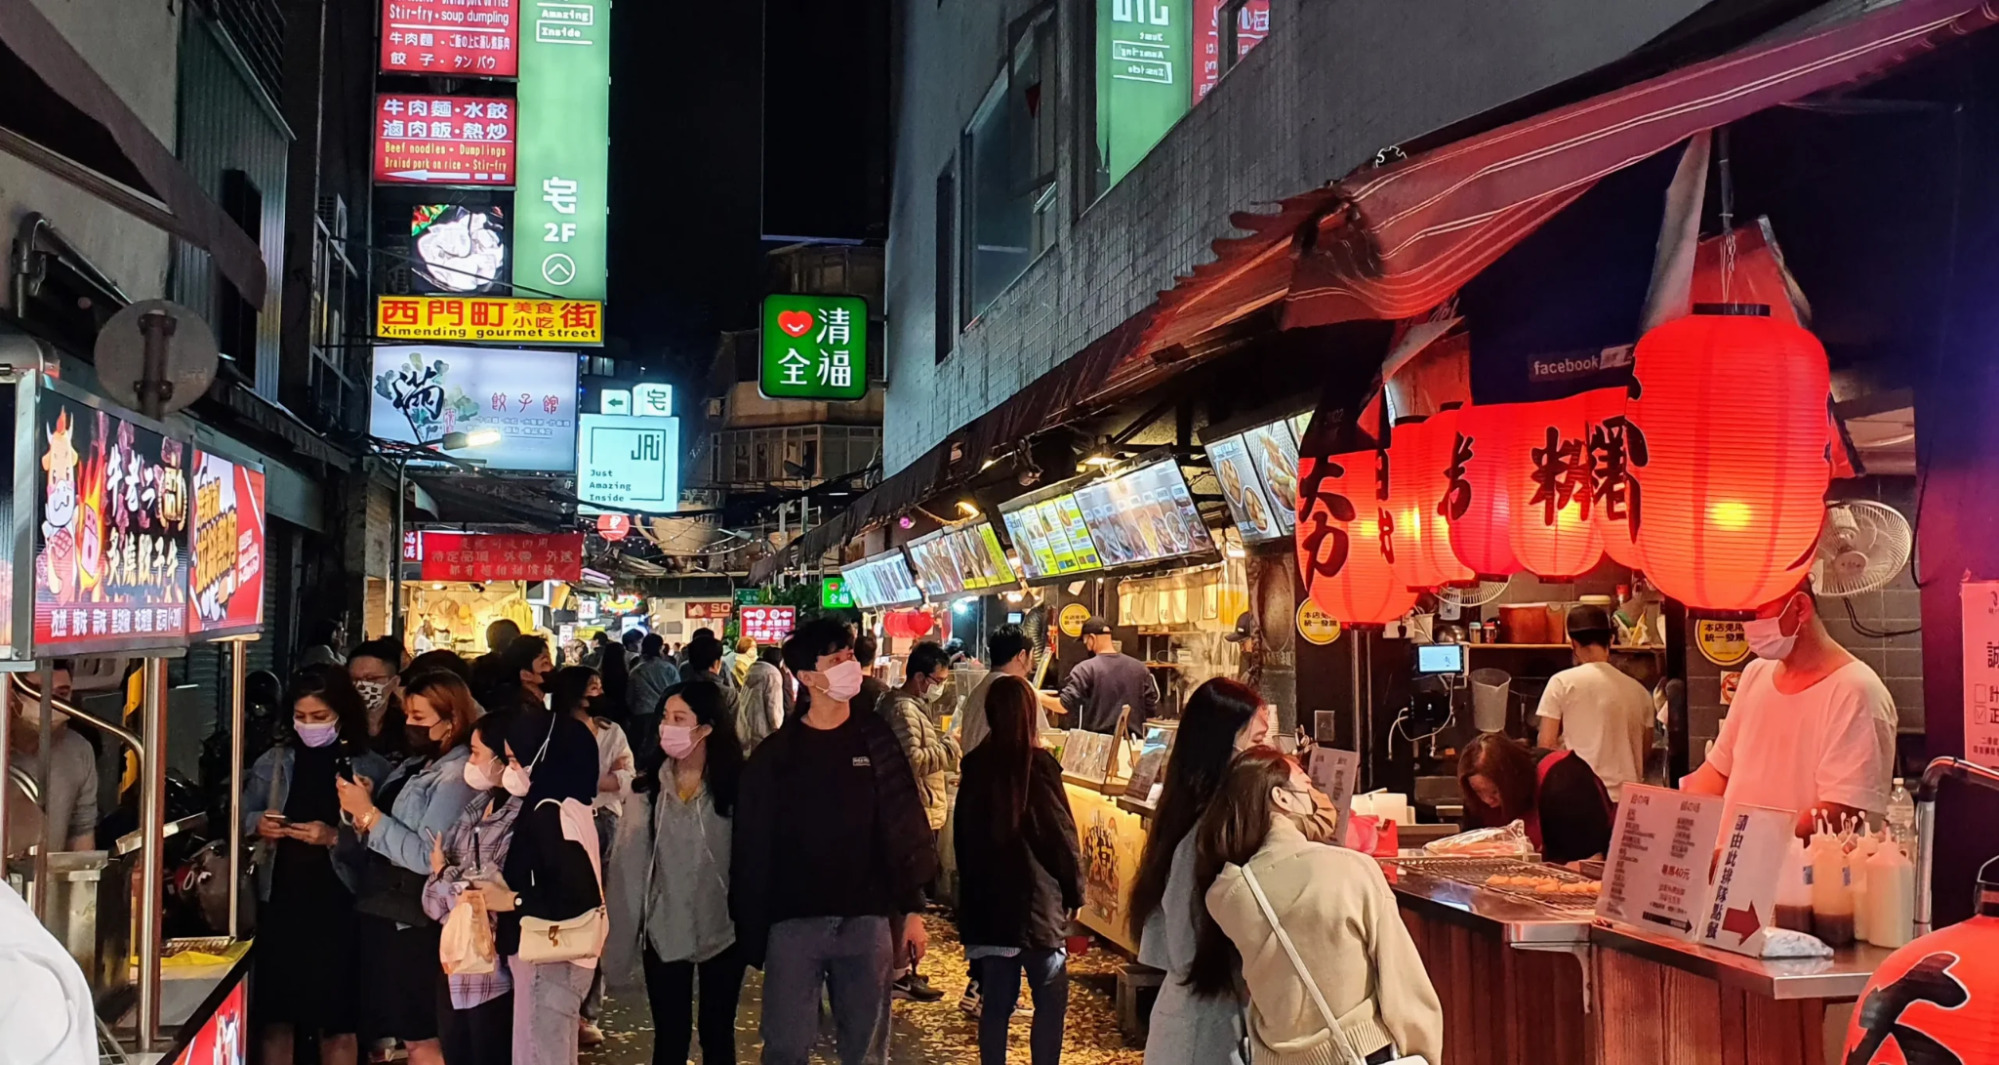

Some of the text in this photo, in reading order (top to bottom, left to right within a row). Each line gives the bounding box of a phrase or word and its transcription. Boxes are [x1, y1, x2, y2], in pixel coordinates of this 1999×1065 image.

[390, 4, 510, 26] Stir-fry soup dumpling
[542, 9, 589, 22] Amazing
[541, 26, 581, 38] Inside
[384, 141, 506, 158] Beef noodles Dumplings
[413, 157, 430, 170] pork
[433, 160, 441, 170] on
[444, 158, 462, 170] rice
[472, 158, 507, 173] Stir-fry
[543, 176, 577, 215] 宅
[543, 223, 576, 243] 2F
[381, 300, 597, 329] 西門町 美食 小吃 街
[381, 325, 596, 339] Ximending gourmet street
[1533, 354, 1599, 375] facebook
[491, 392, 559, 415] 餃子館
[647, 389, 667, 412] 宅
[590, 469, 613, 477] Just
[589, 481, 632, 491] Amazing
[589, 493, 625, 502] Inside
